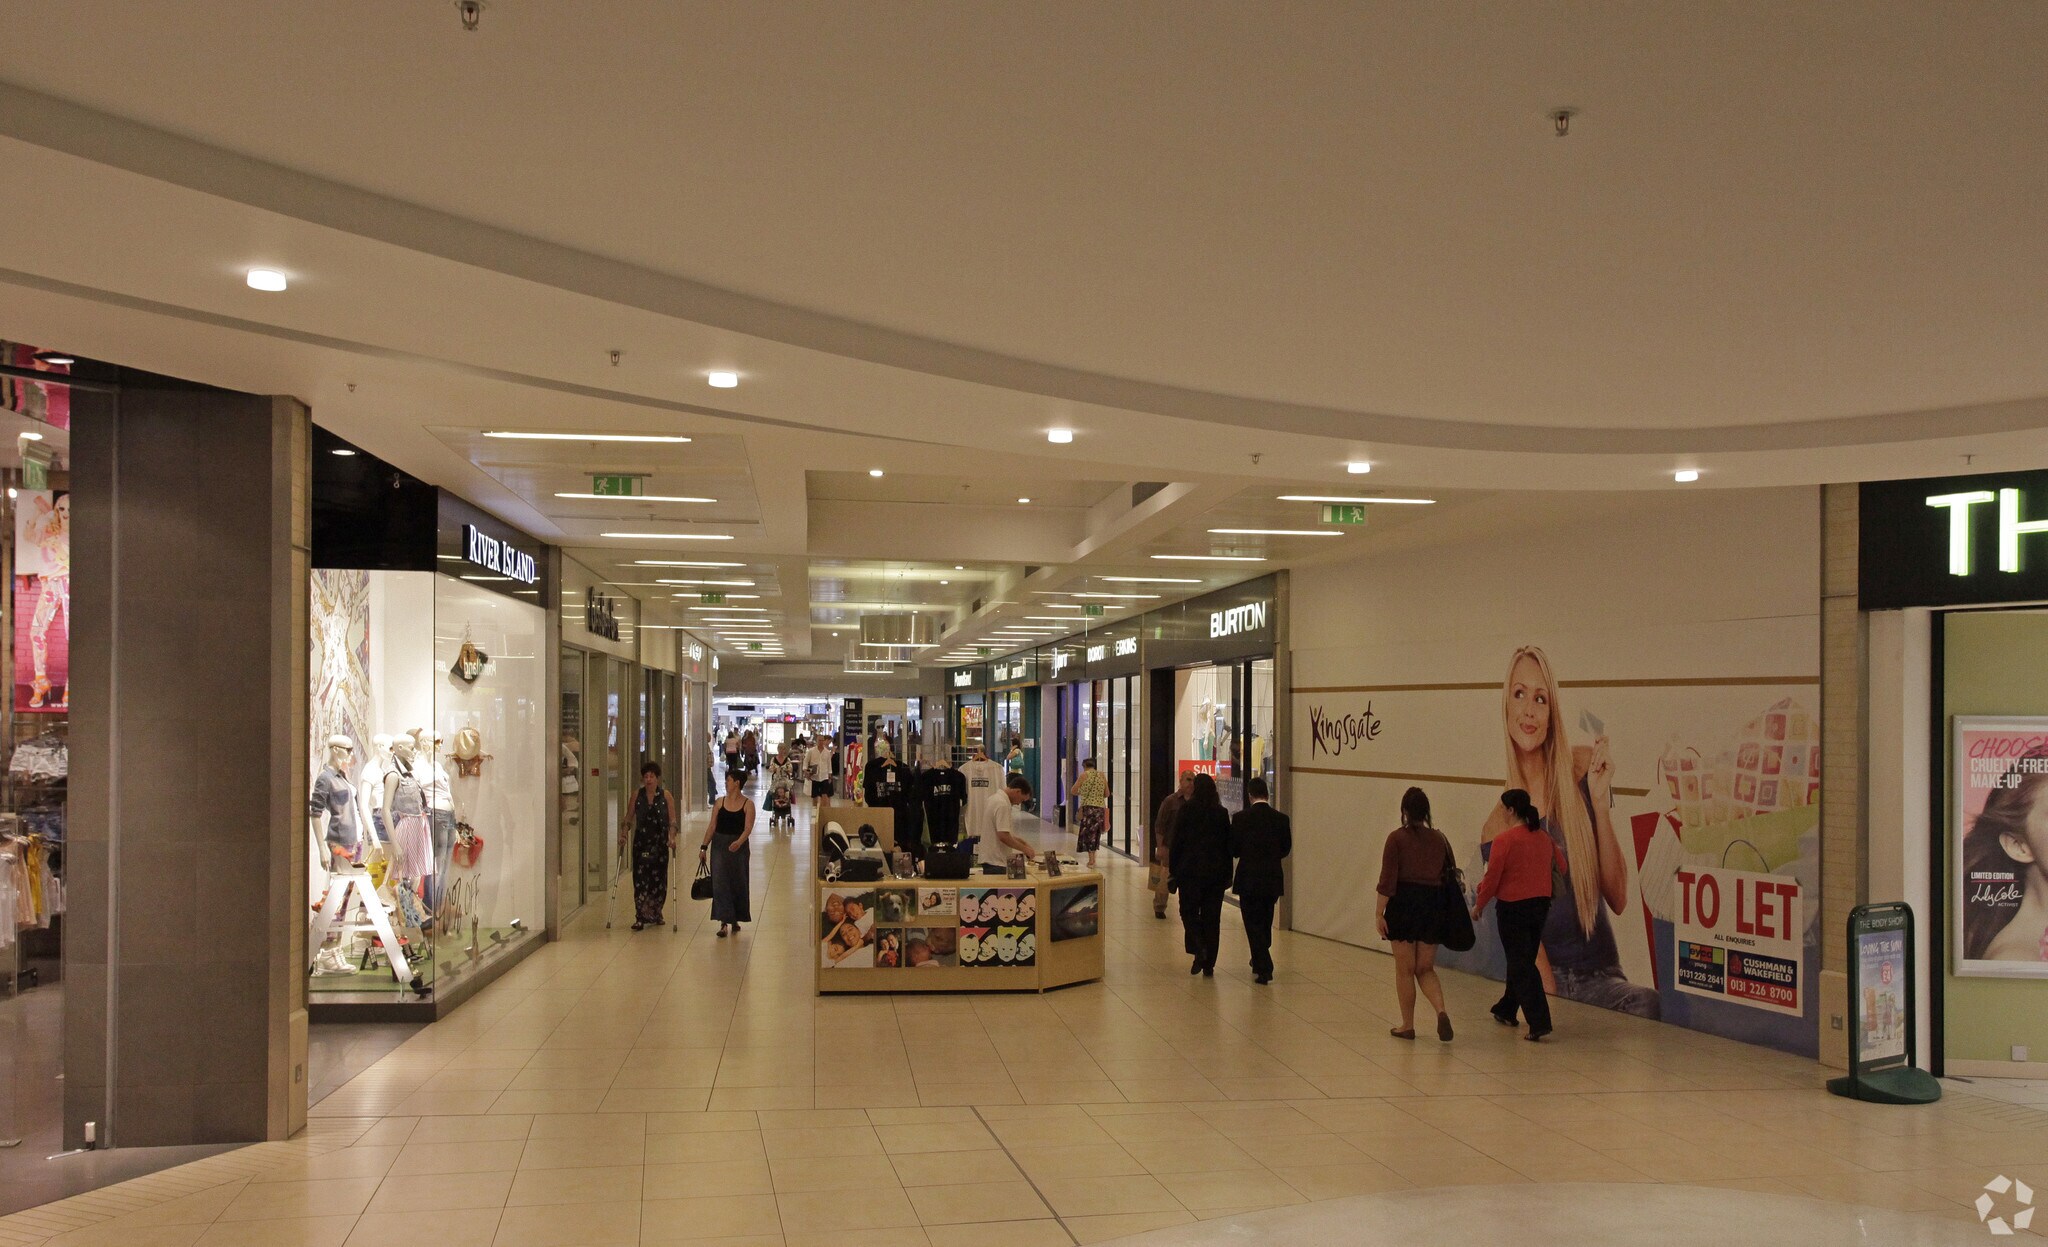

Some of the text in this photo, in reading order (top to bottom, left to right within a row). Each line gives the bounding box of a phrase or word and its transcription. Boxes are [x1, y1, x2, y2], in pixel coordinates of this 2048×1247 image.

[469, 524, 535, 584] RIVER ISLAND
[1210, 601, 1266, 639] BURTON
[1309, 700, 1382, 760] Kingsgate
[1971, 773, 2022, 789] MAKE-UP
[1971, 871, 2014, 880] LIMITED EDITION
[1677, 871, 1798, 941] TO LET
[1860, 916, 1904, 929] THE BODY SHOP
[1725, 936, 1755, 947] ENQUIRIES
[1743, 958, 1794, 975] CUSHMAN &
[1743, 966, 1792, 982] WAKEFIELD
[1679, 968, 1724, 986] 0131 226 2641
[1730, 979, 1746, 992] 0131
[1749, 982, 1766, 996] 226
[1769, 987, 1793, 1001] 8700
